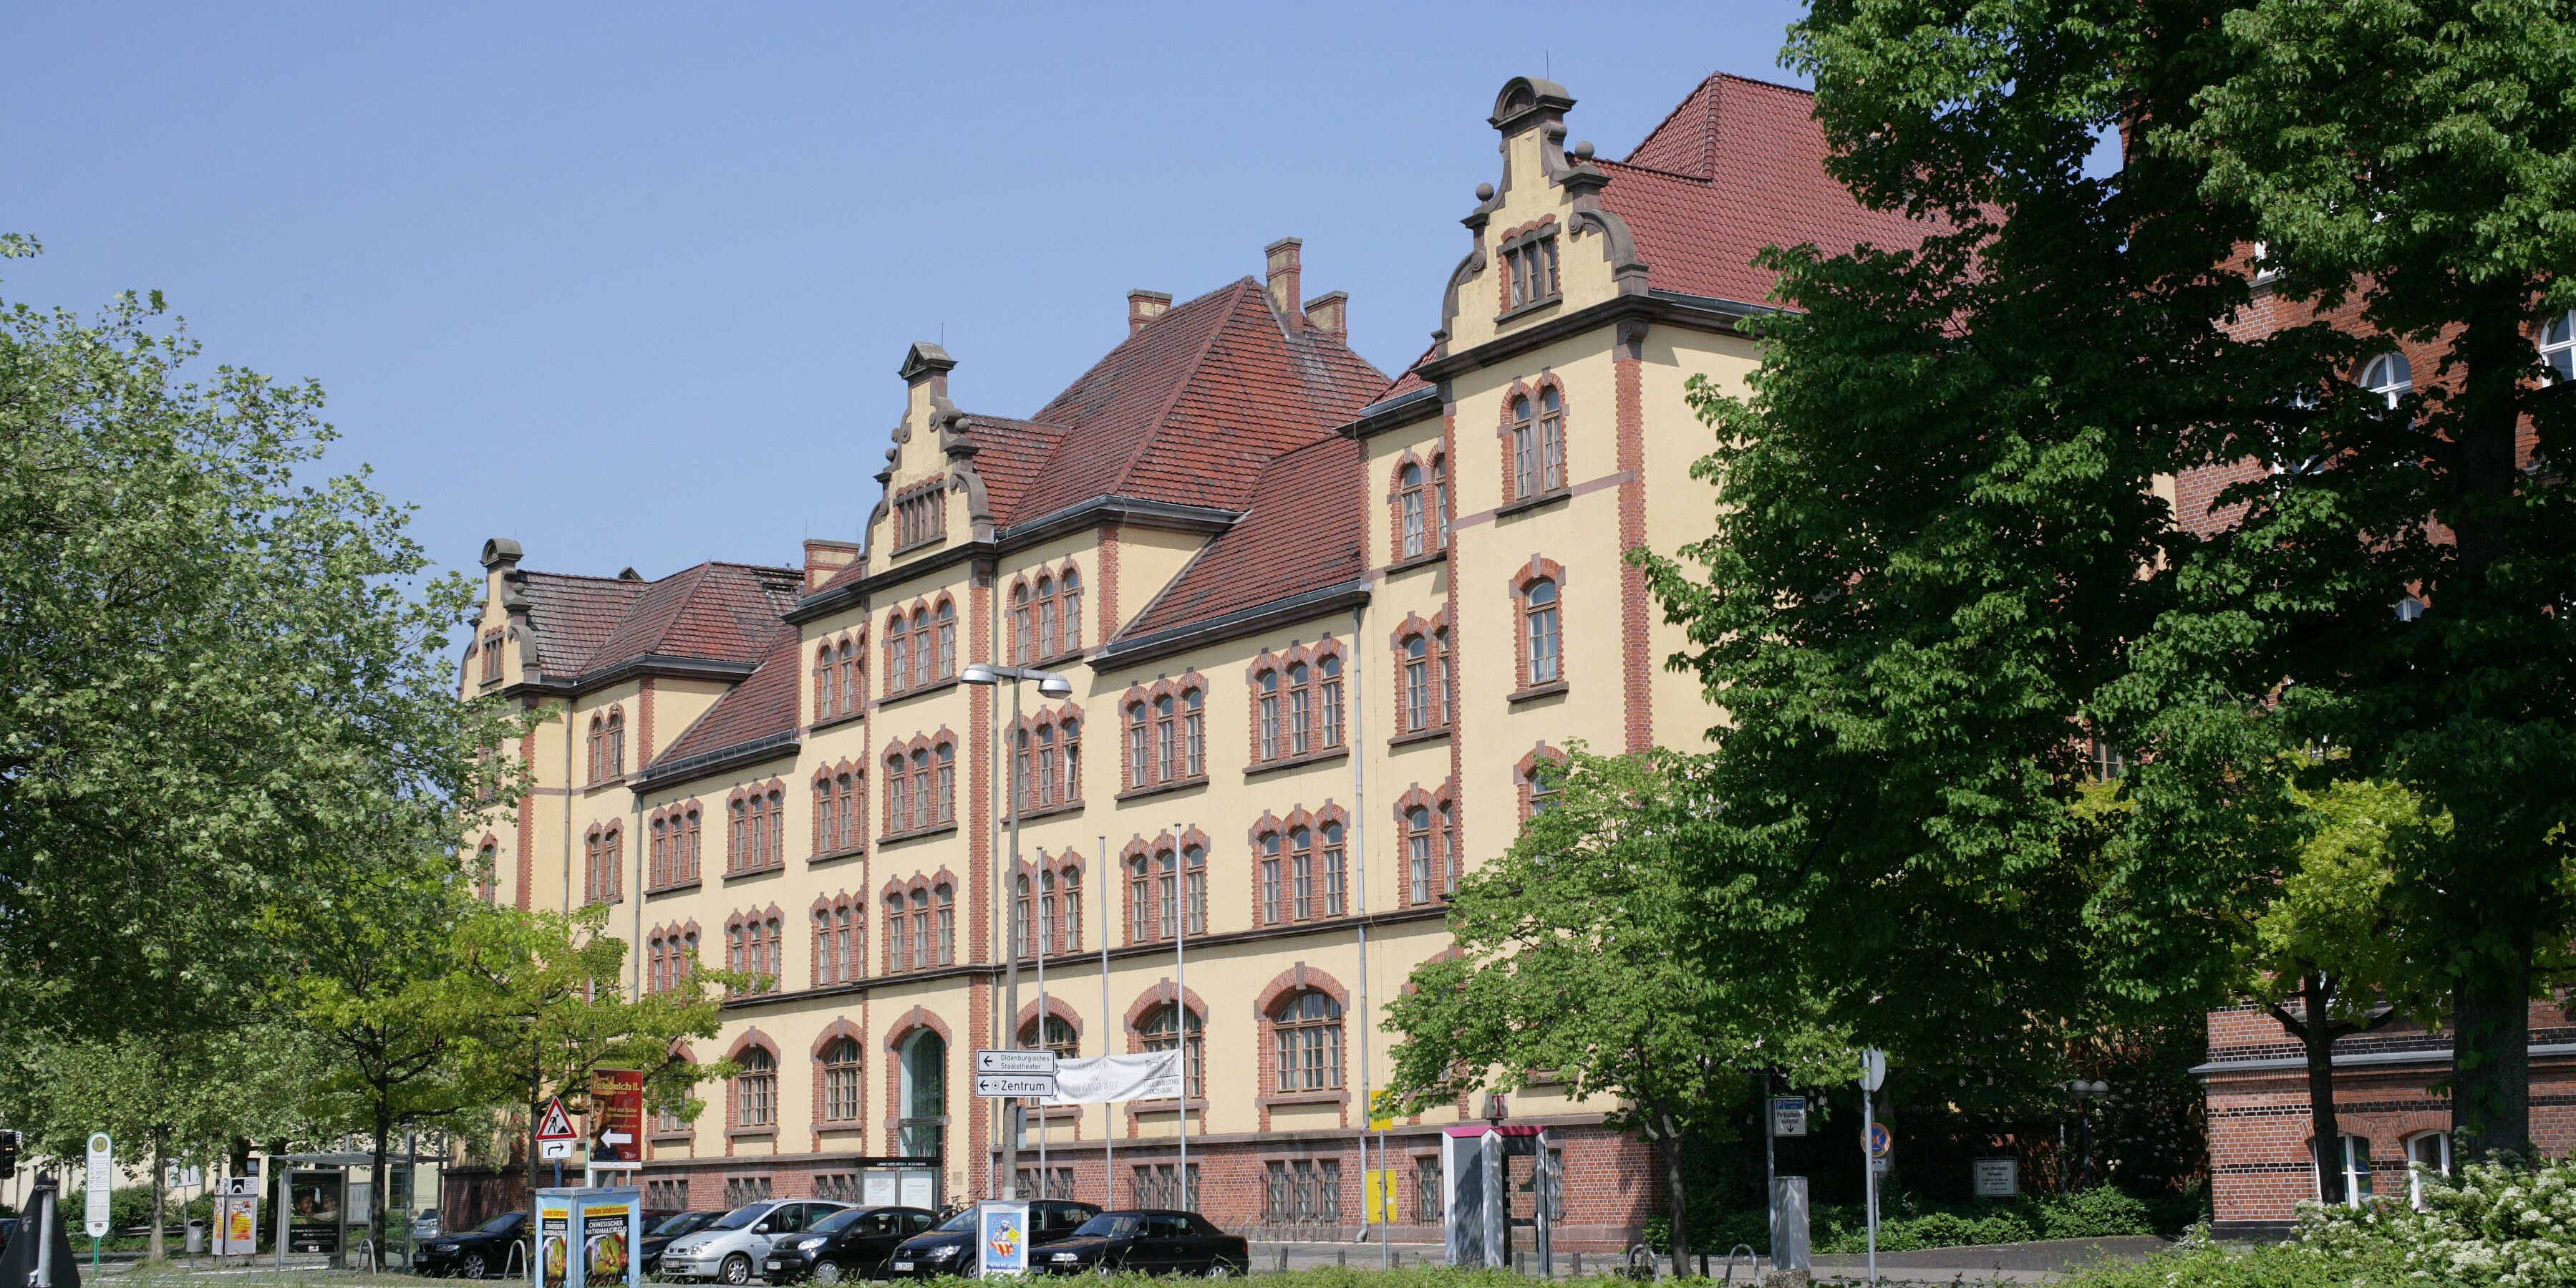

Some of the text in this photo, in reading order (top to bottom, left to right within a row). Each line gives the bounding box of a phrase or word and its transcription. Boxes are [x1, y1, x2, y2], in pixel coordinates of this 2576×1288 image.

[1000, 1054, 1050, 1062] Oldenburgisches
[1001, 1080, 1045, 1091] Zentrum
[1491, 1095, 1505, 1117] T
[589, 1220, 624, 1229] CHINESISCHER
[585, 1226, 628, 1235] NATIONALCIRCUS
